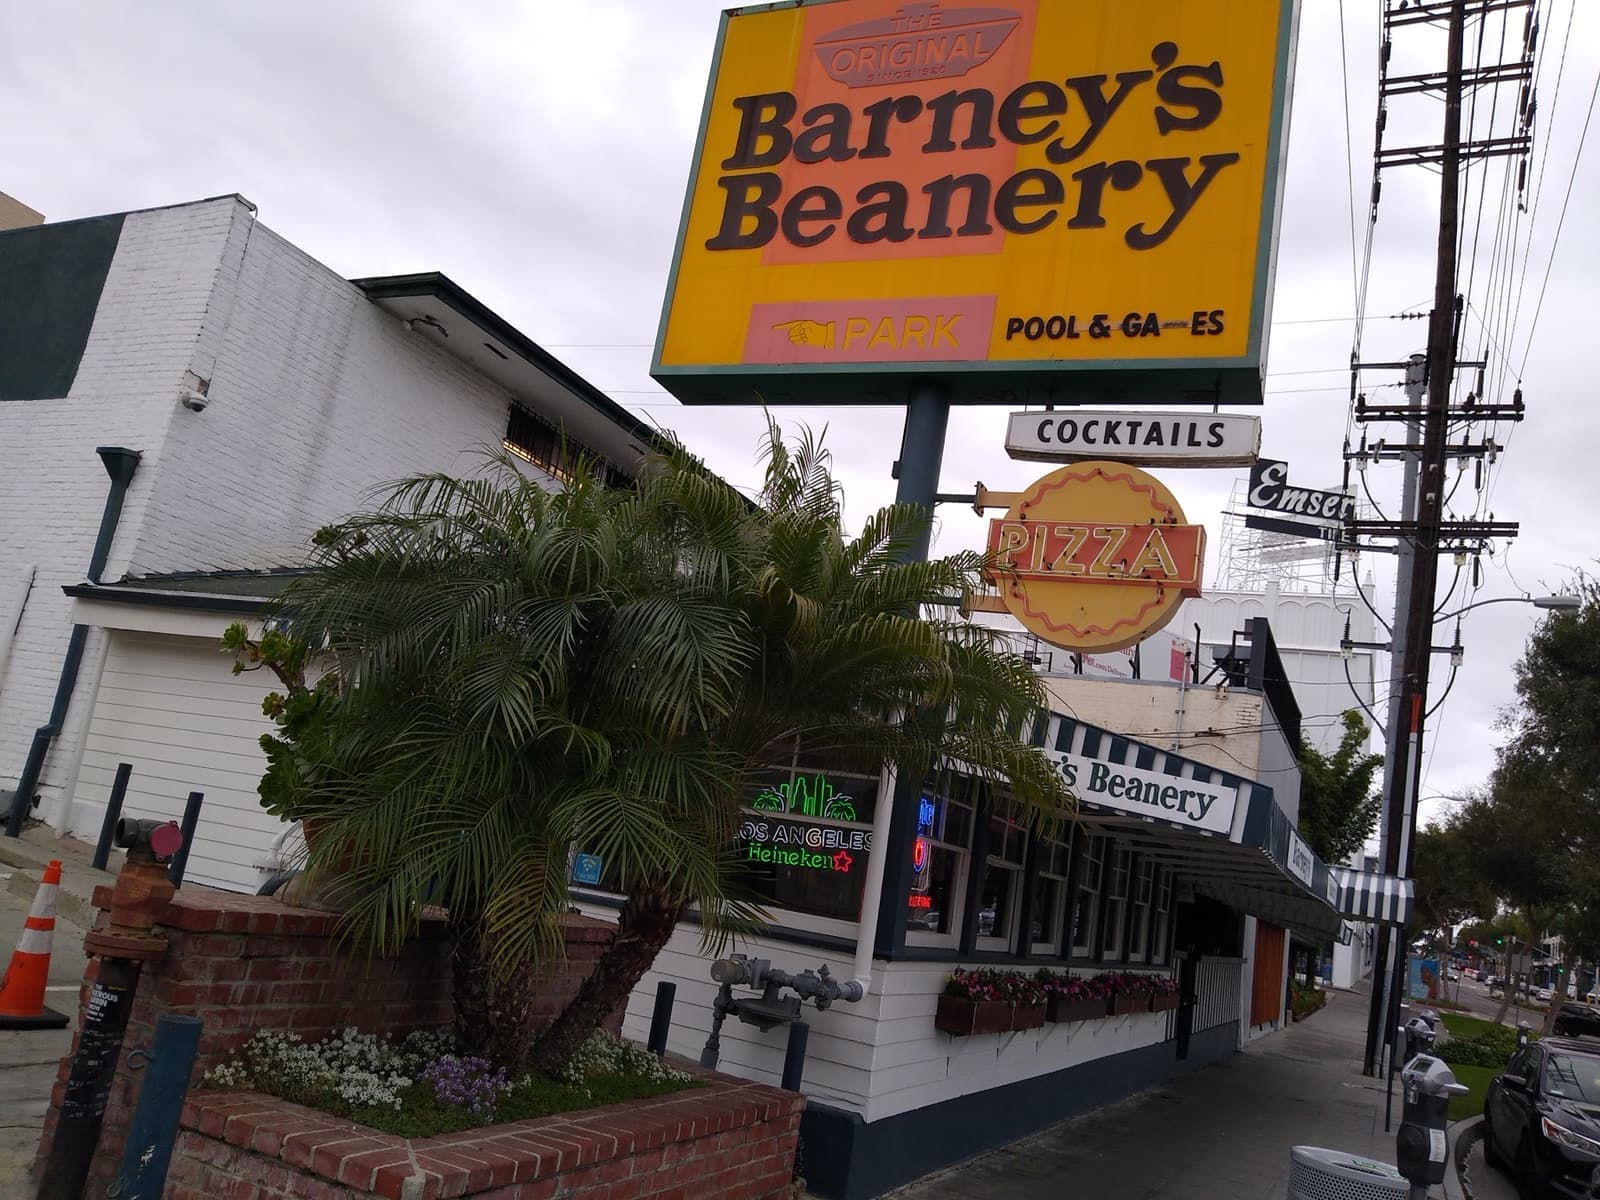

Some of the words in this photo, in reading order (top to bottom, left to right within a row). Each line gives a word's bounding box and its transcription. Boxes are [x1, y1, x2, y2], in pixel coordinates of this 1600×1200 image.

[888, 12, 945, 33] THE
[831, 31, 991, 74] ORIGINAL
[866, 69, 913, 82] SINCE
[721, 41, 1224, 170] Barney's
[705, 152, 1240, 251] Beanery
[842, 313, 964, 351] PARK
[1005, 316, 1081, 341] POOL
[1088, 313, 1112, 339] &
[1037, 418, 1225, 448] COCKTAILS
[1249, 462, 1355, 520] Emser
[996, 523, 1179, 577] PIZZA
[1087, 762, 1218, 821] Beanery
[734, 822, 769, 842] OS
[773, 825, 873, 851] ANGELES
[749, 843, 834, 869] Heineken
